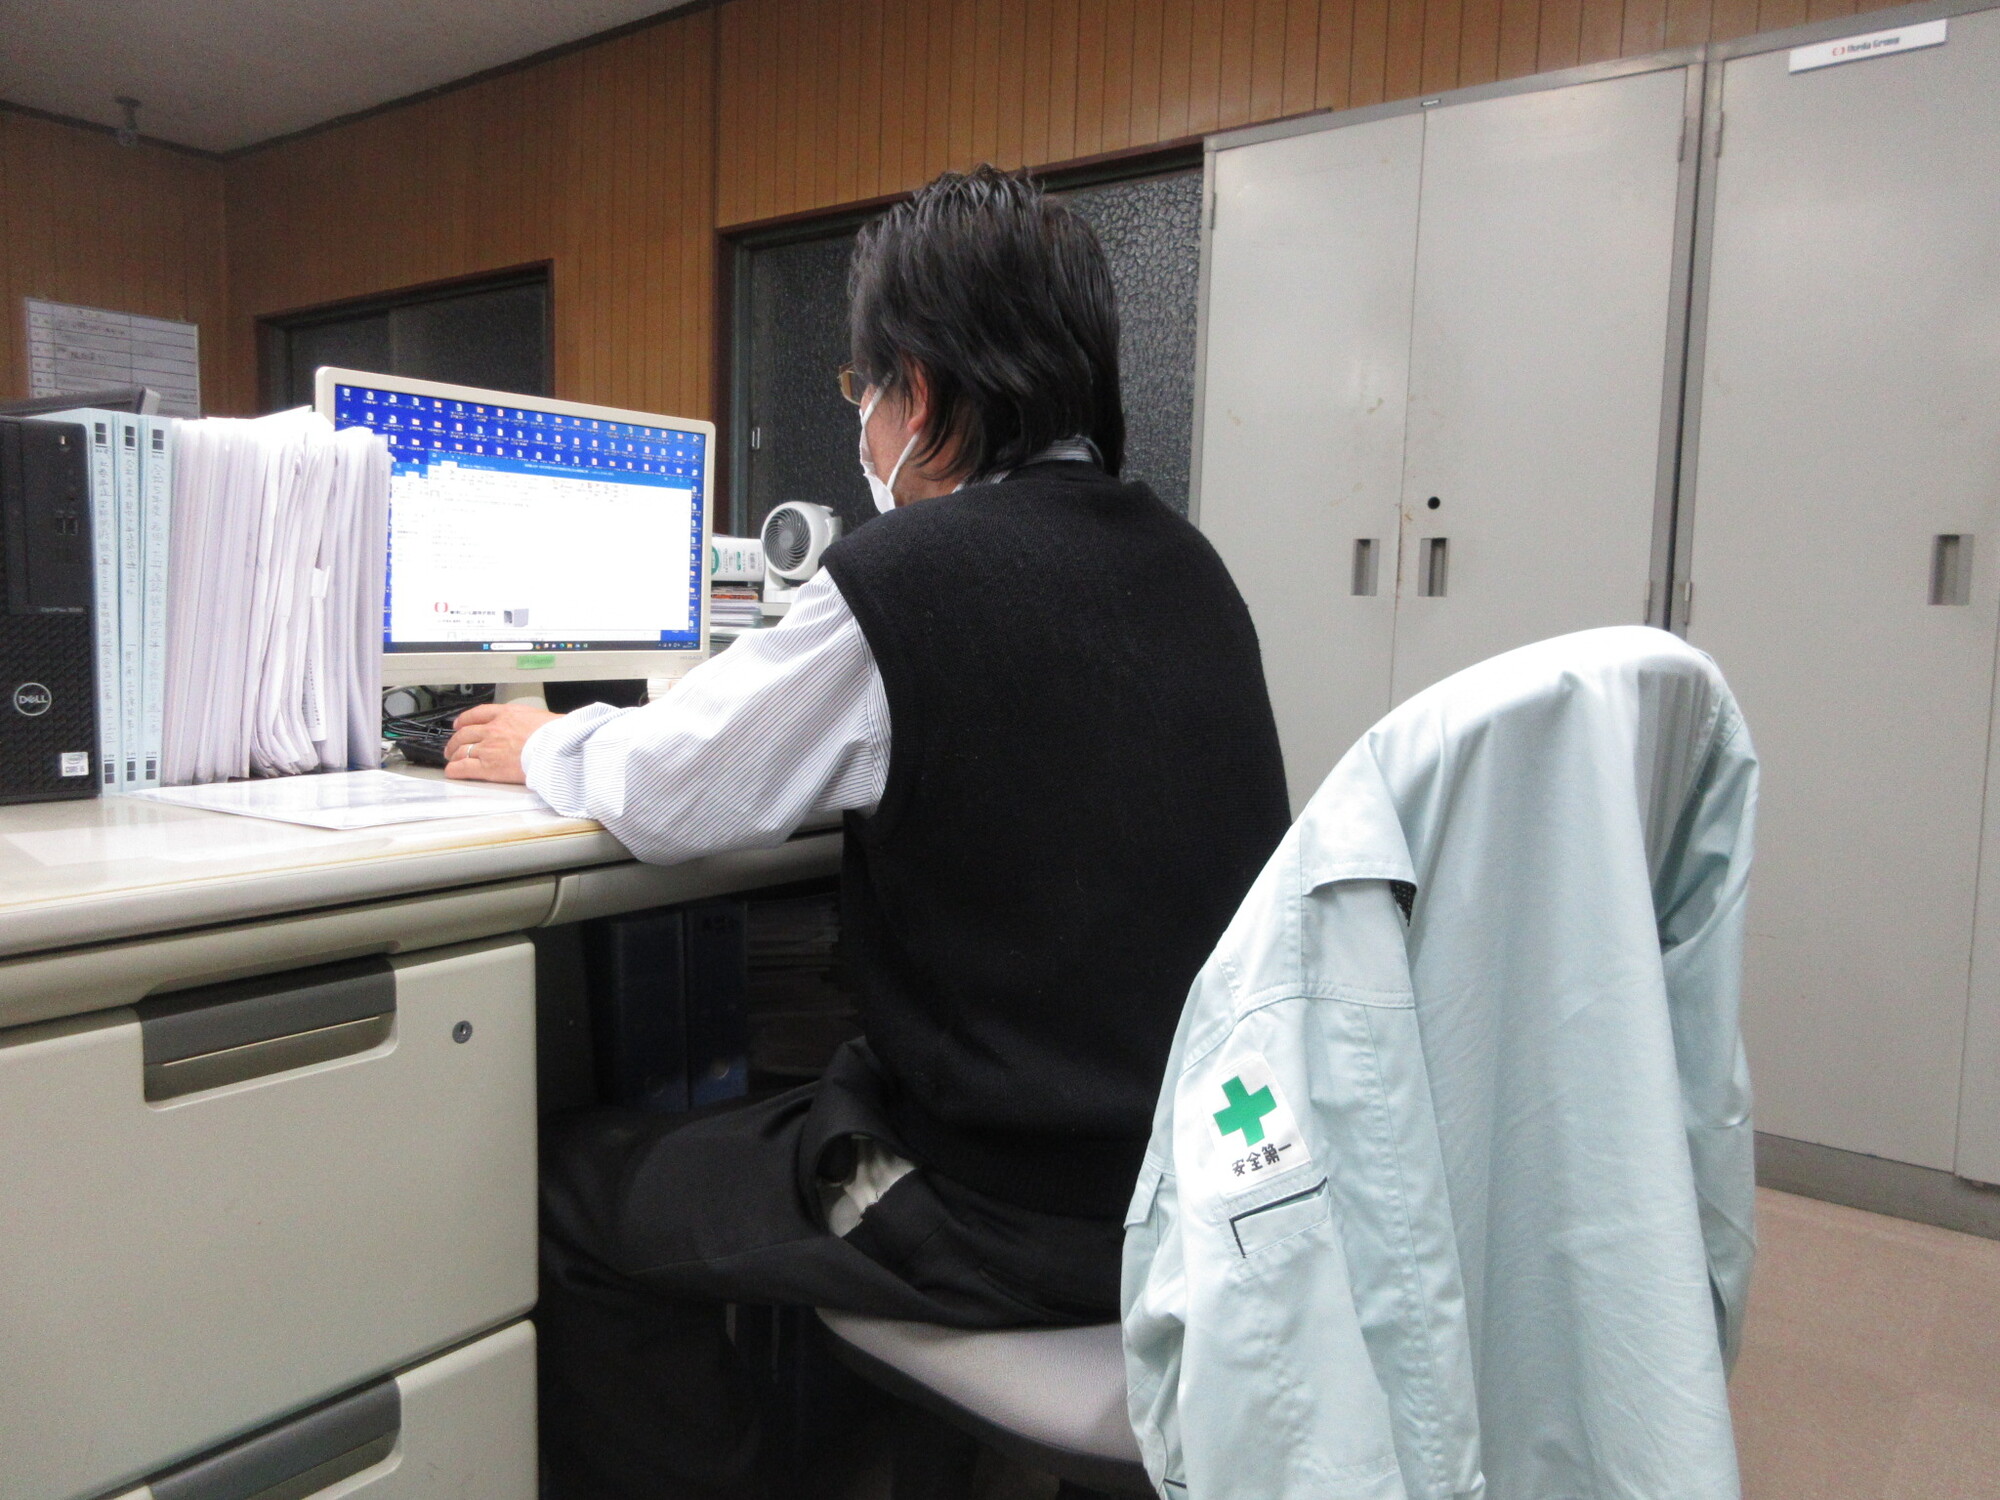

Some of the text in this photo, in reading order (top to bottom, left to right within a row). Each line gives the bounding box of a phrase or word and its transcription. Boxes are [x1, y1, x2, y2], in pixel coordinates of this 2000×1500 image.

[19, 694, 48, 704] DELL
[1232, 1143, 1292, 1177] 安全第一
